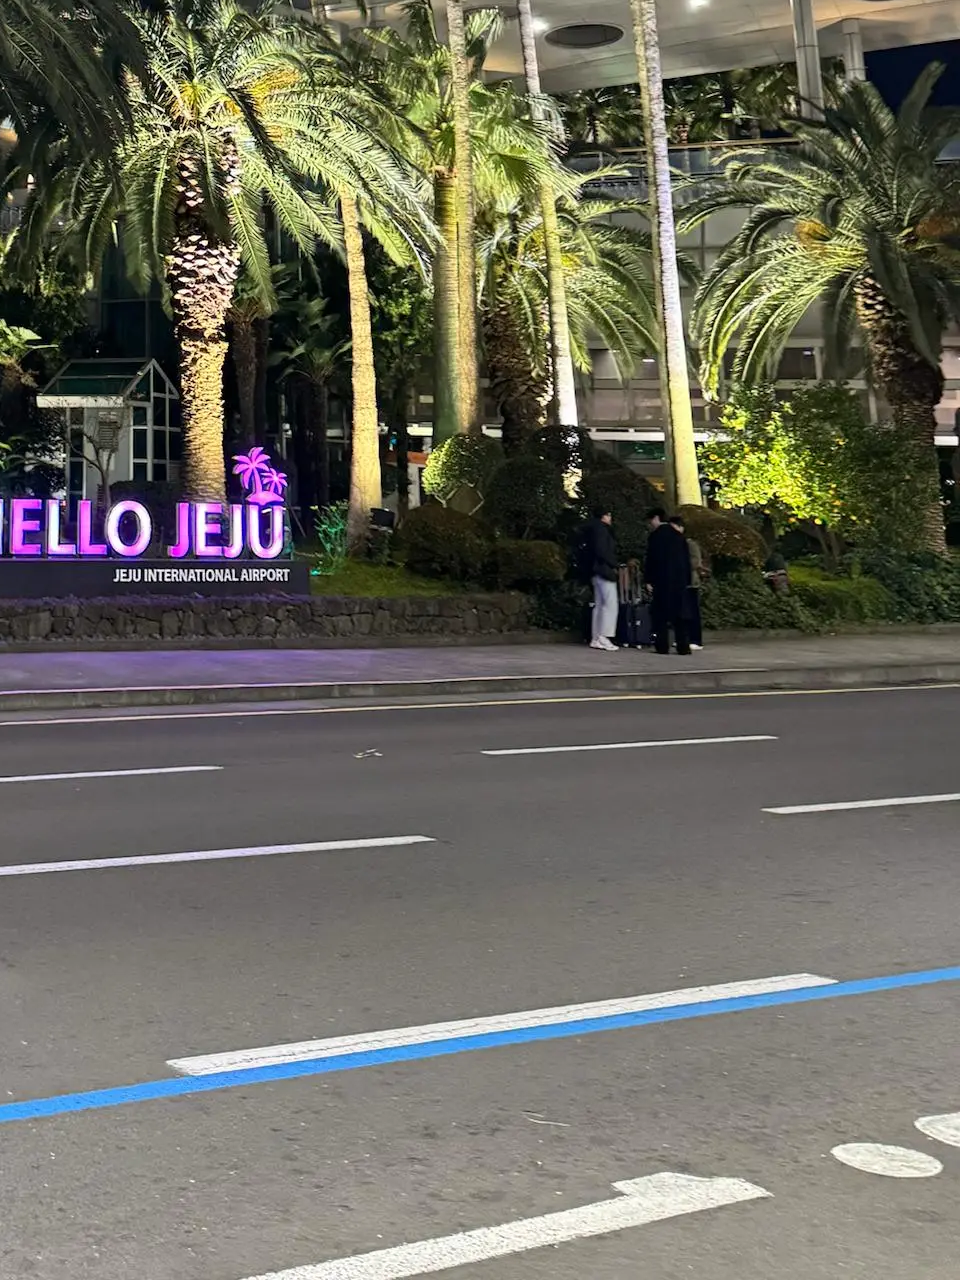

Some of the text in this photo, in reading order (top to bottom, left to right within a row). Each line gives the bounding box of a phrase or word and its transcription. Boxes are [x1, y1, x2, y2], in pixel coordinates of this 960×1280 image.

[167, 501, 286, 559] JEJU
[113, 568, 291, 583] JEJU INTERNATIONAL AIRPORT
